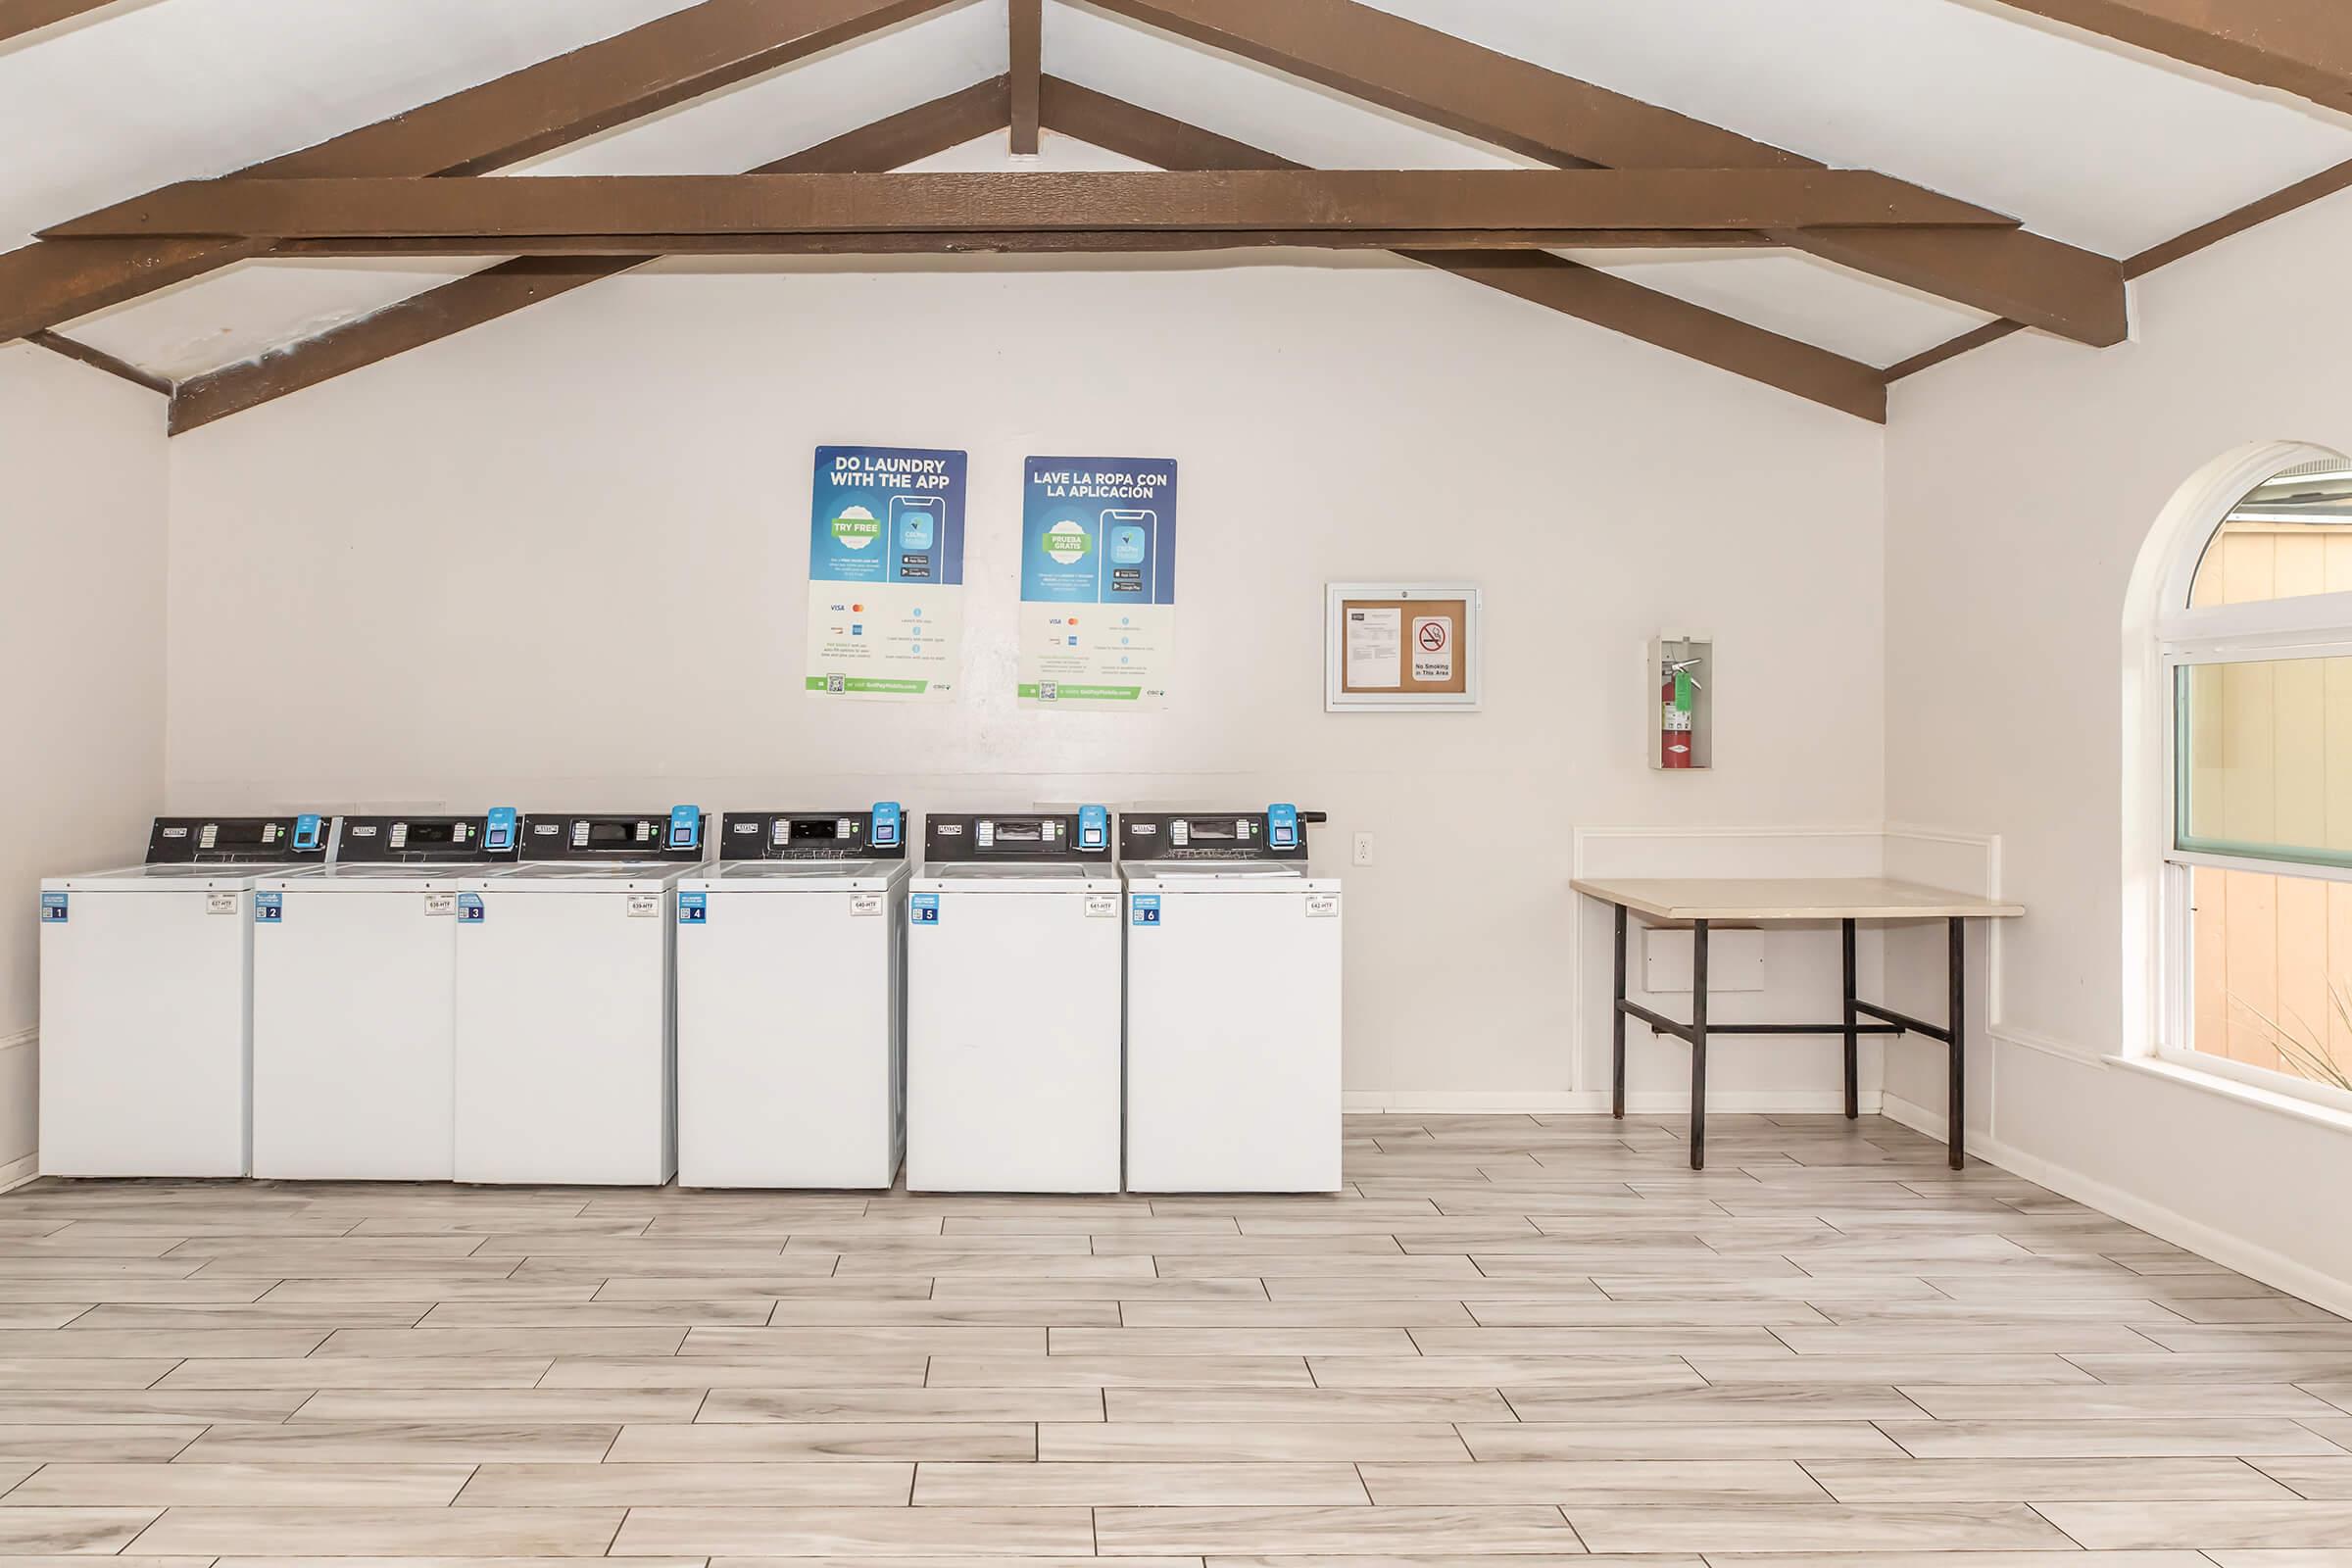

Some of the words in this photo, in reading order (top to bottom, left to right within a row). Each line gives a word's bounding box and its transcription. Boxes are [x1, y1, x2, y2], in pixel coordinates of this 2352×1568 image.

[836, 457, 860, 470] DO
[864, 457, 946, 474] LAUNDRY
[831, 472, 874, 487] WITH
[878, 473, 911, 488] THE
[915, 474, 950, 489] APP
[1034, 471, 1070, 484] LAVE
[1073, 472, 1092, 484] LA
[1096, 473, 1133, 486] ROPA
[1137, 474, 1167, 486] CON
[1047, 485, 1065, 497] LA
[1069, 484, 1153, 499] APLICACIÓN
[834, 522, 851, 532] TRY
[854, 523, 878, 532] FREE
[57, 908, 62, 917] 1
[270, 907, 276, 917] 2
[472, 908, 479, 918] 3
[694, 908, 701, 918] 4
[926, 909, 933, 919] 5
[1148, 910, 1154, 920] 6
